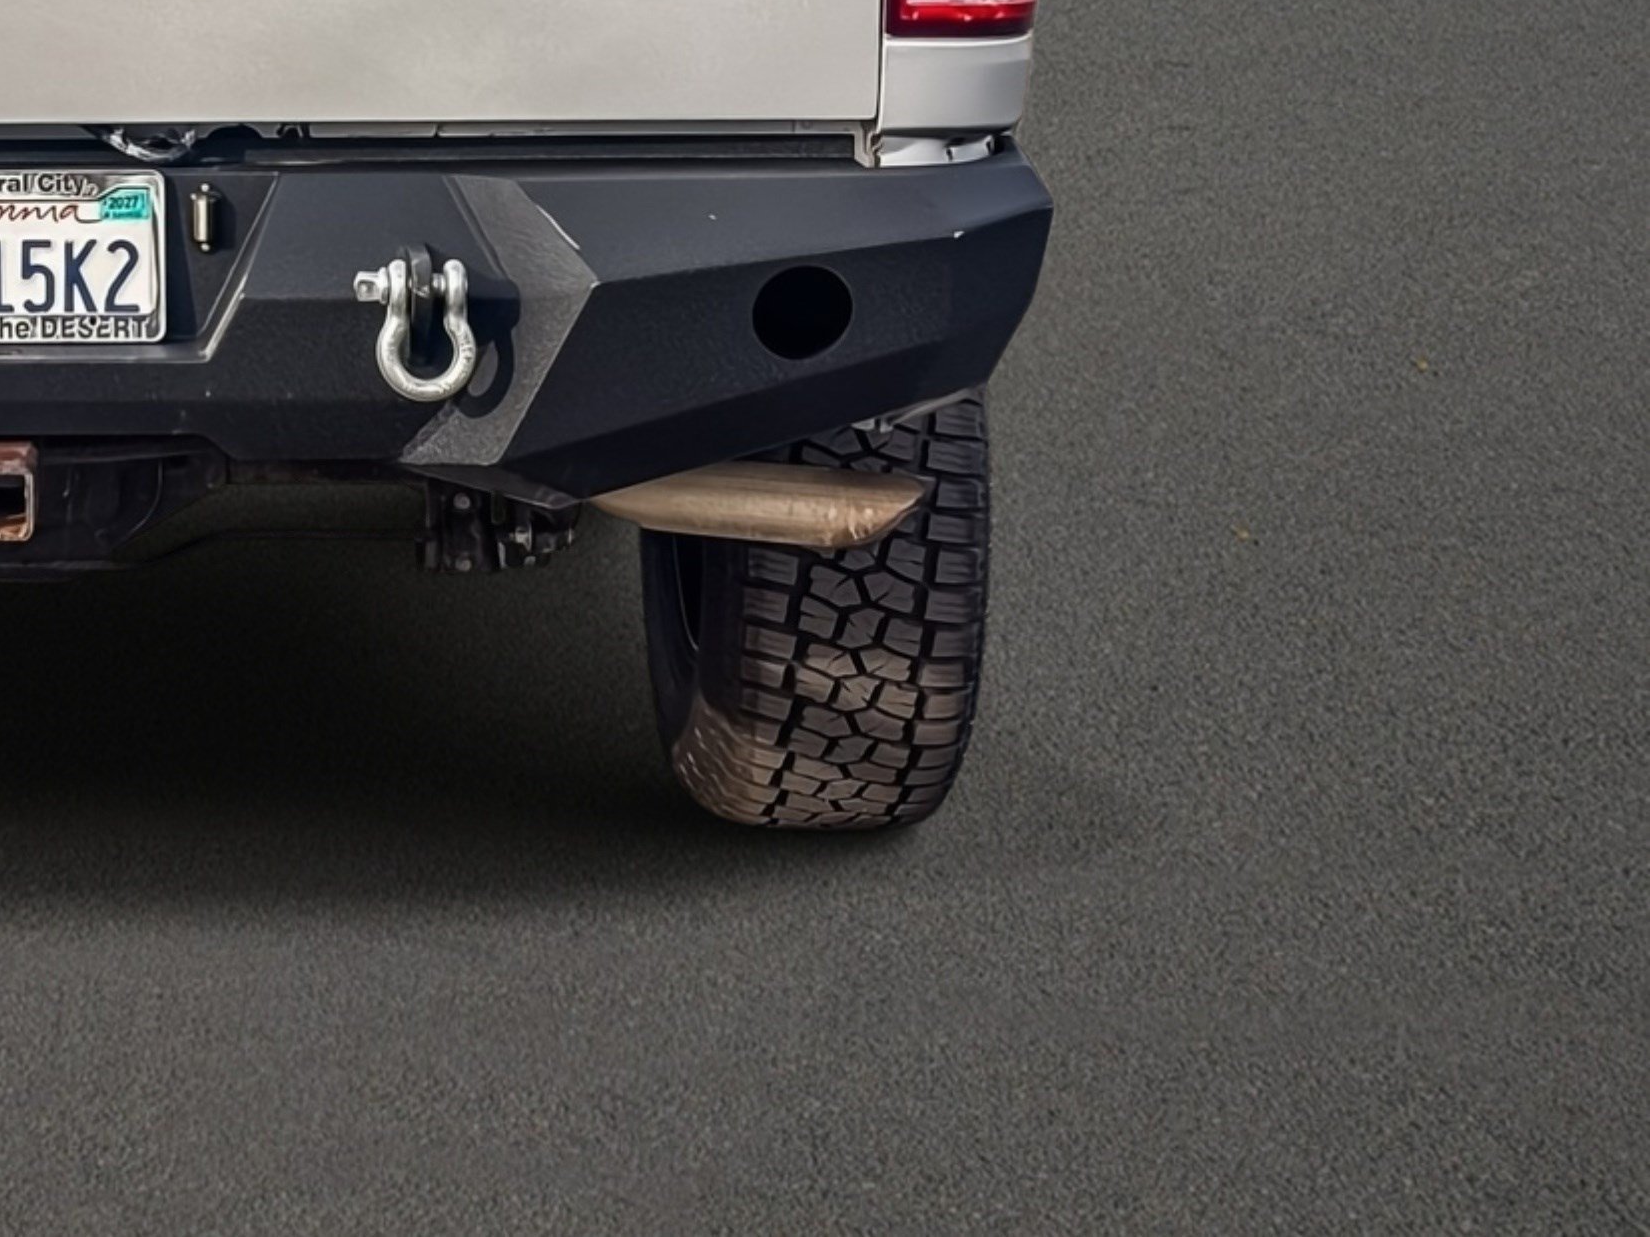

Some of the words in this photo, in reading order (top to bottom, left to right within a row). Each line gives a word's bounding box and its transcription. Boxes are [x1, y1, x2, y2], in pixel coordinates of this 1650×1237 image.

[38, 173, 84, 196] City
[108, 194, 139, 210] 2027
[41, 315, 150, 340] DESERT
